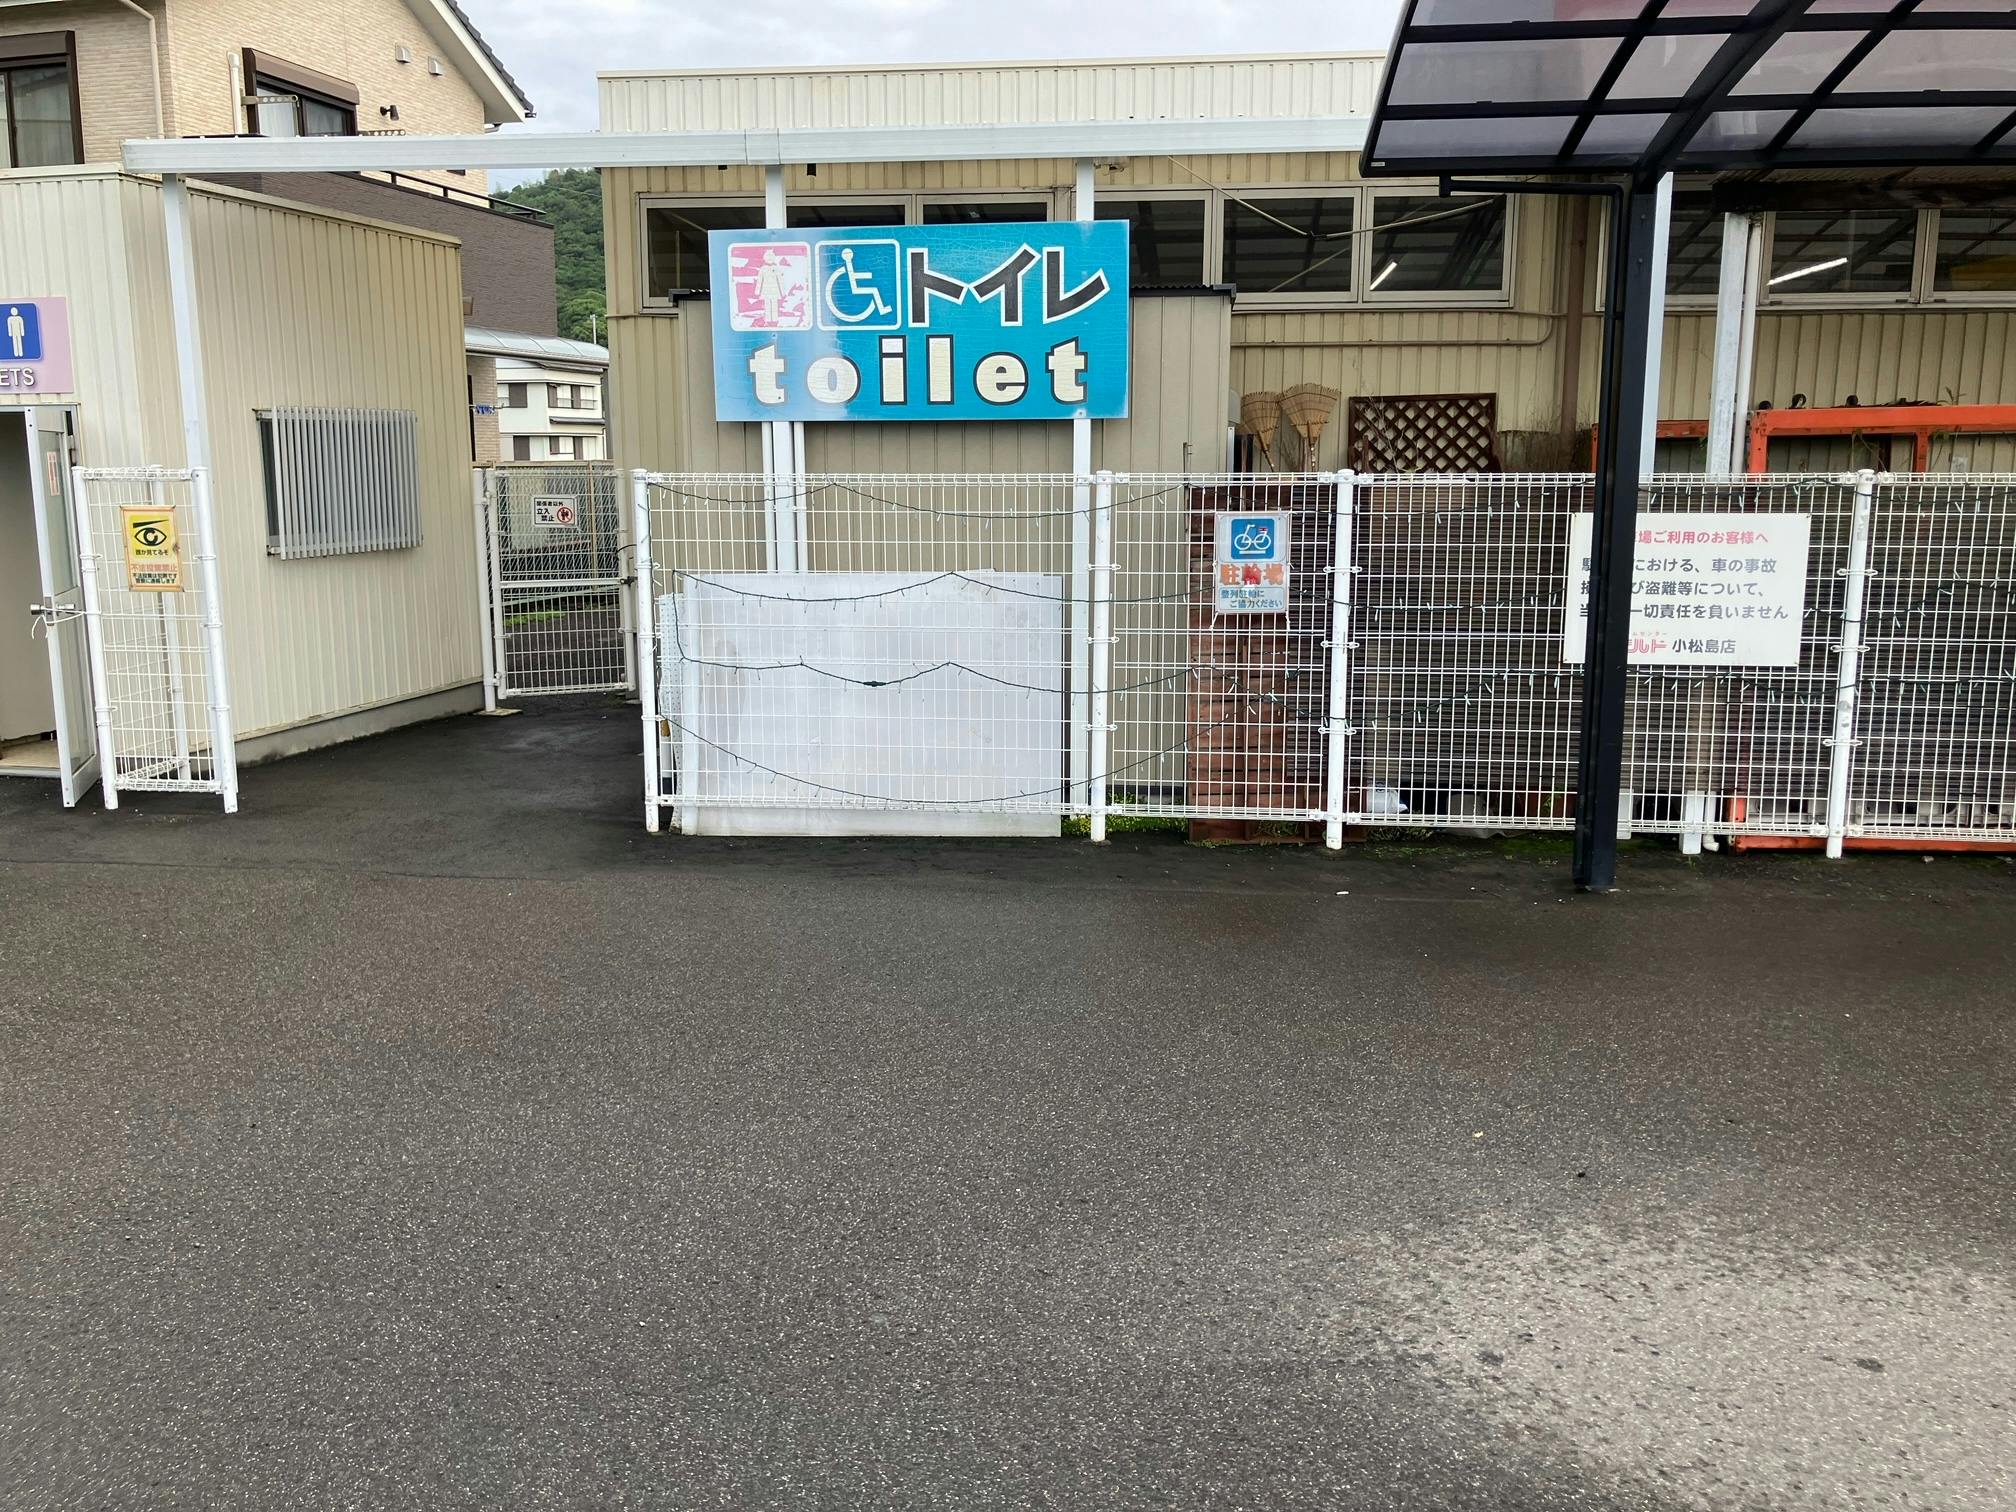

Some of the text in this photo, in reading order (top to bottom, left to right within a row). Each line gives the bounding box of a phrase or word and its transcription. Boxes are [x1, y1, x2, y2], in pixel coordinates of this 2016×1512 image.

[907, 242, 1111, 328] トイレ
[747, 334, 1088, 405] toilet
[1635, 529, 1769, 545] 場ご利用のお客様へ
[1220, 563, 1284, 585] 駐輪場
[1230, 599, 1283, 608] ご協力ください
[1672, 639, 1737, 654] 小松島店
